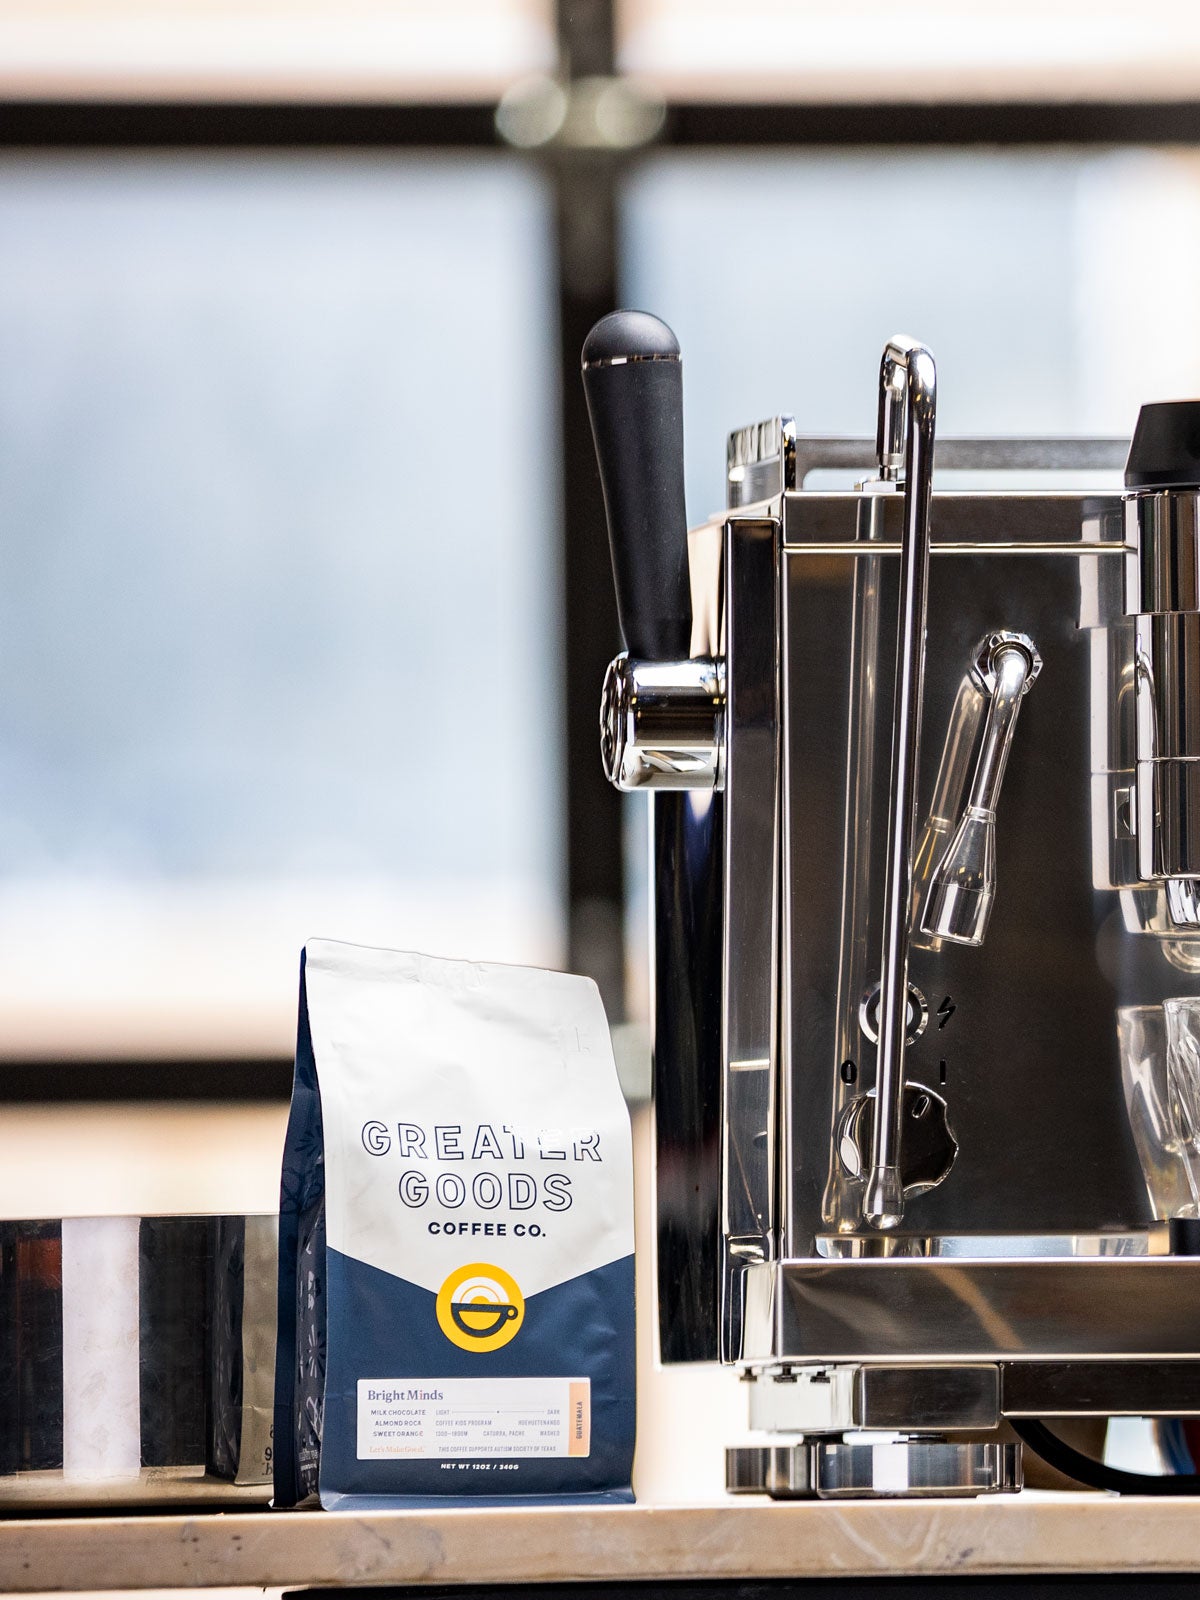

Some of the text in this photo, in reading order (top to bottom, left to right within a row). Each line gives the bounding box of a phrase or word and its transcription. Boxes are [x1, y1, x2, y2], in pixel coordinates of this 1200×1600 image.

[398, 1170, 573, 1212] GOODS
[427, 1221, 547, 1238] COFFEE CO.
[367, 1389, 444, 1404] Bright Minds
[575, 1401, 583, 1440] GUATEMALA
